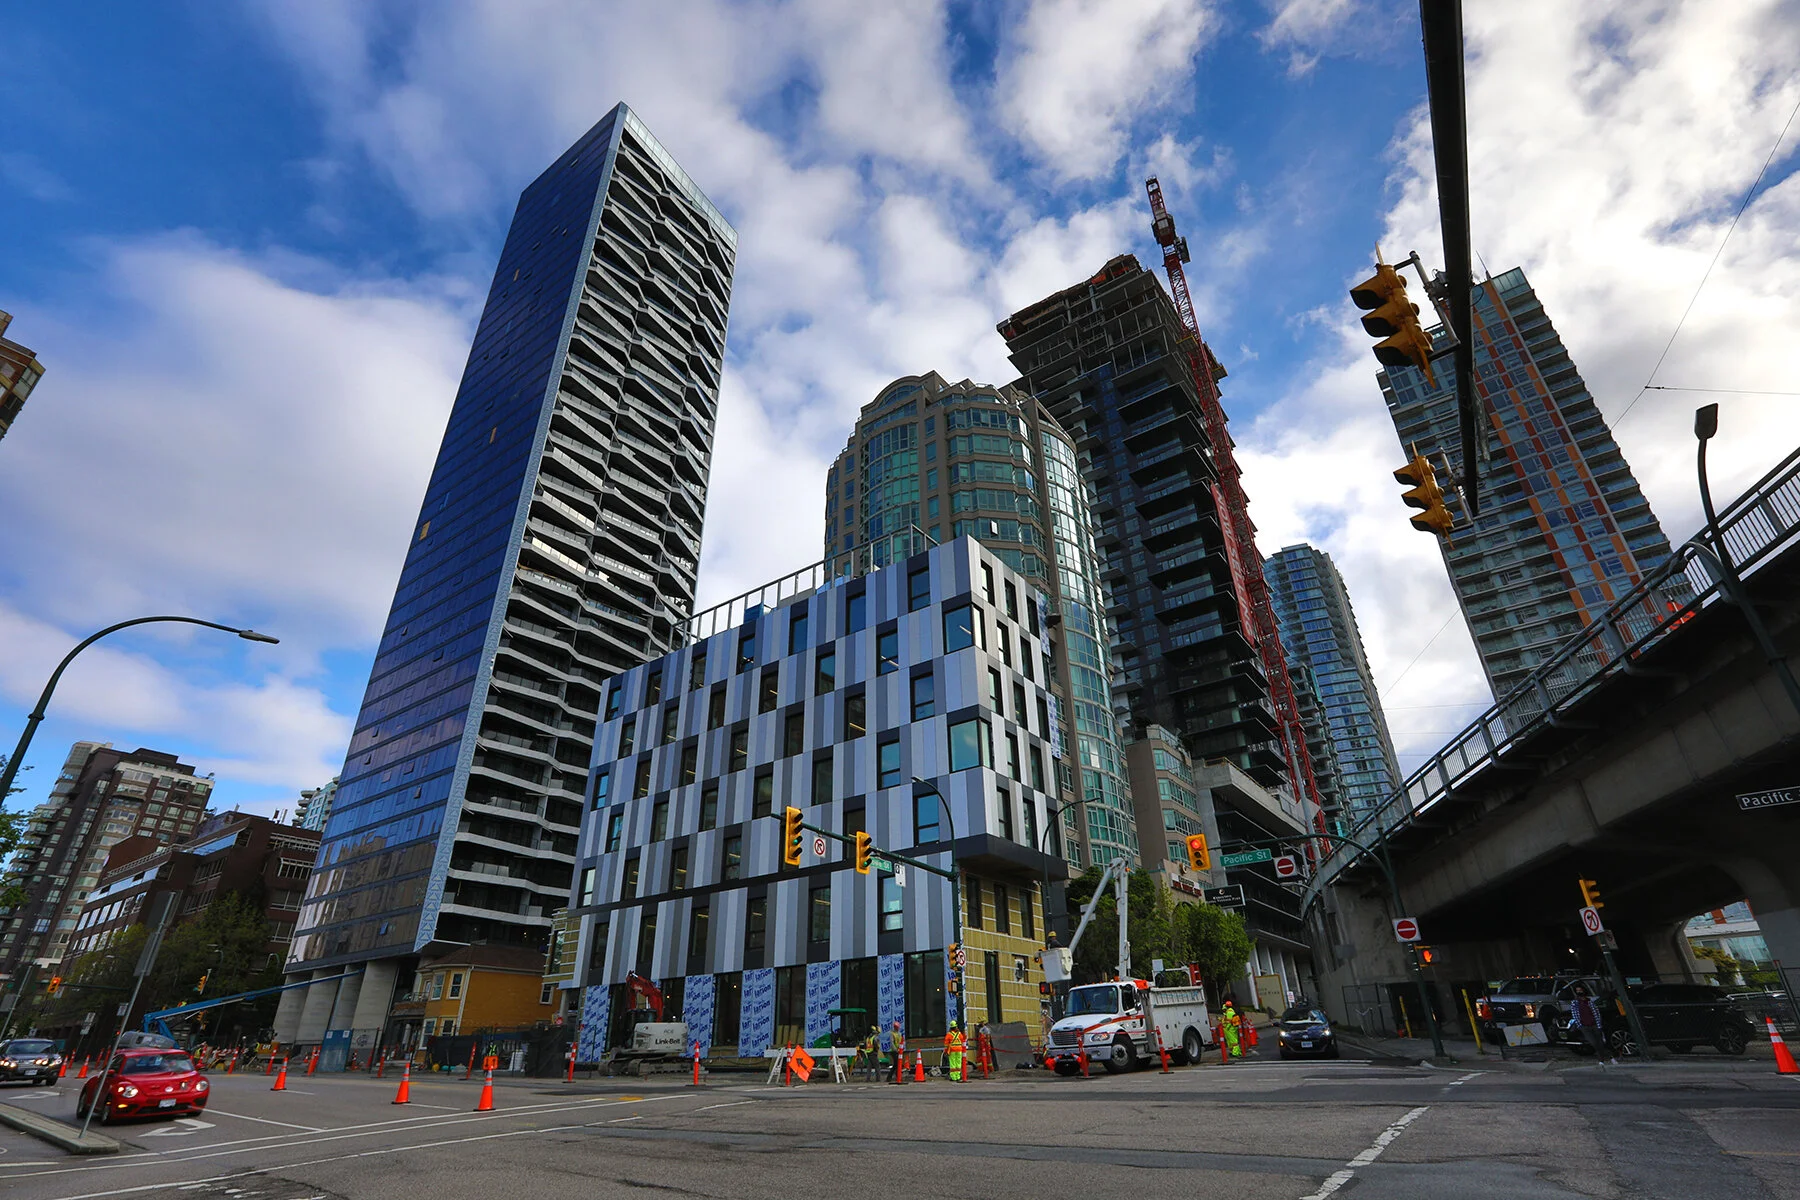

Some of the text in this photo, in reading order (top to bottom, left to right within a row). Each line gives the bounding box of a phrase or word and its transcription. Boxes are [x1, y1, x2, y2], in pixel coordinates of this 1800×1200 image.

[1216, 489, 1252, 636] NOW SELLING
[1742, 792, 1794, 807] Pacific
[1224, 851, 1267, 864] Pacific St
